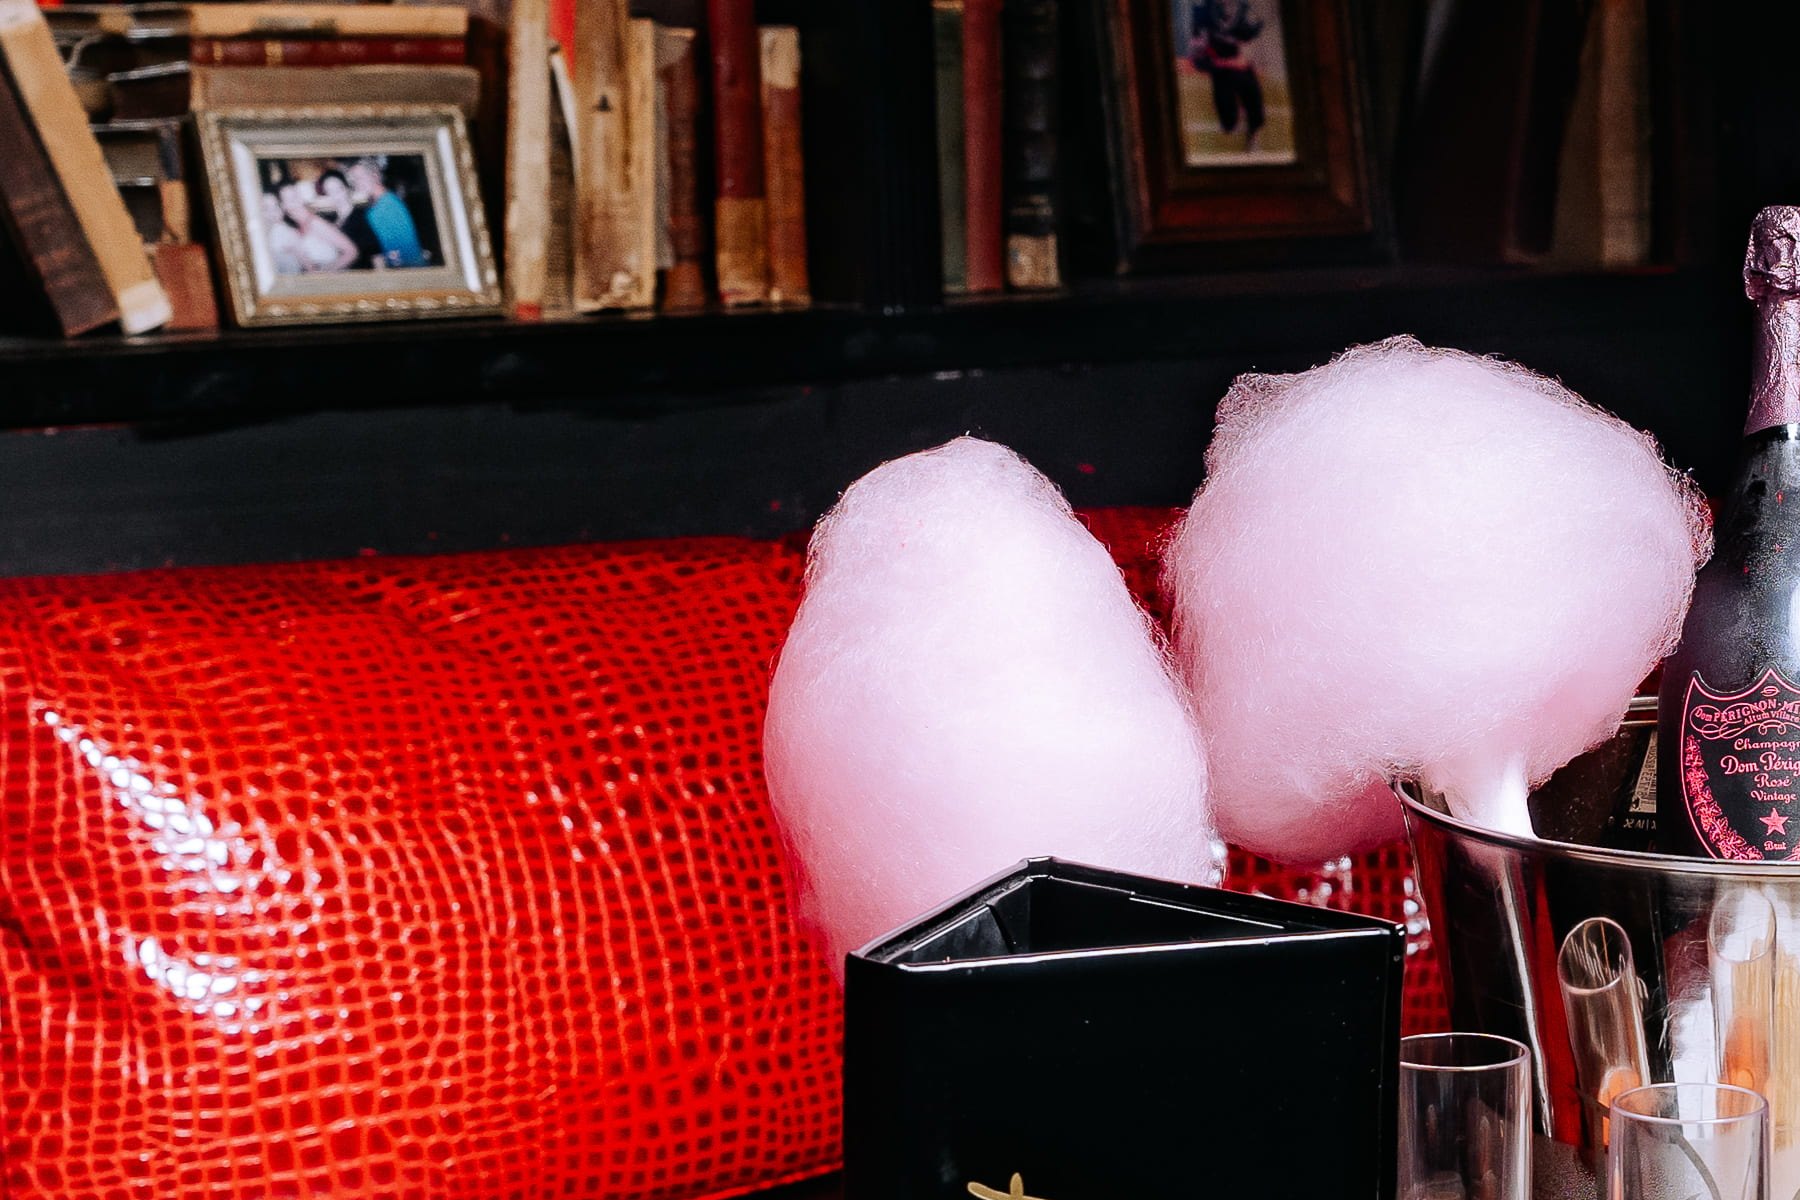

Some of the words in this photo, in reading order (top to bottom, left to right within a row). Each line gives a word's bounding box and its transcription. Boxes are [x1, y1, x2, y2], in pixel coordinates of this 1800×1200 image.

[1720, 755, 1759, 775] Dom
[1754, 775, 1792, 788] Rosé
[1750, 791, 1797, 804] Vintage
[1763, 841, 1787, 851] Brut
